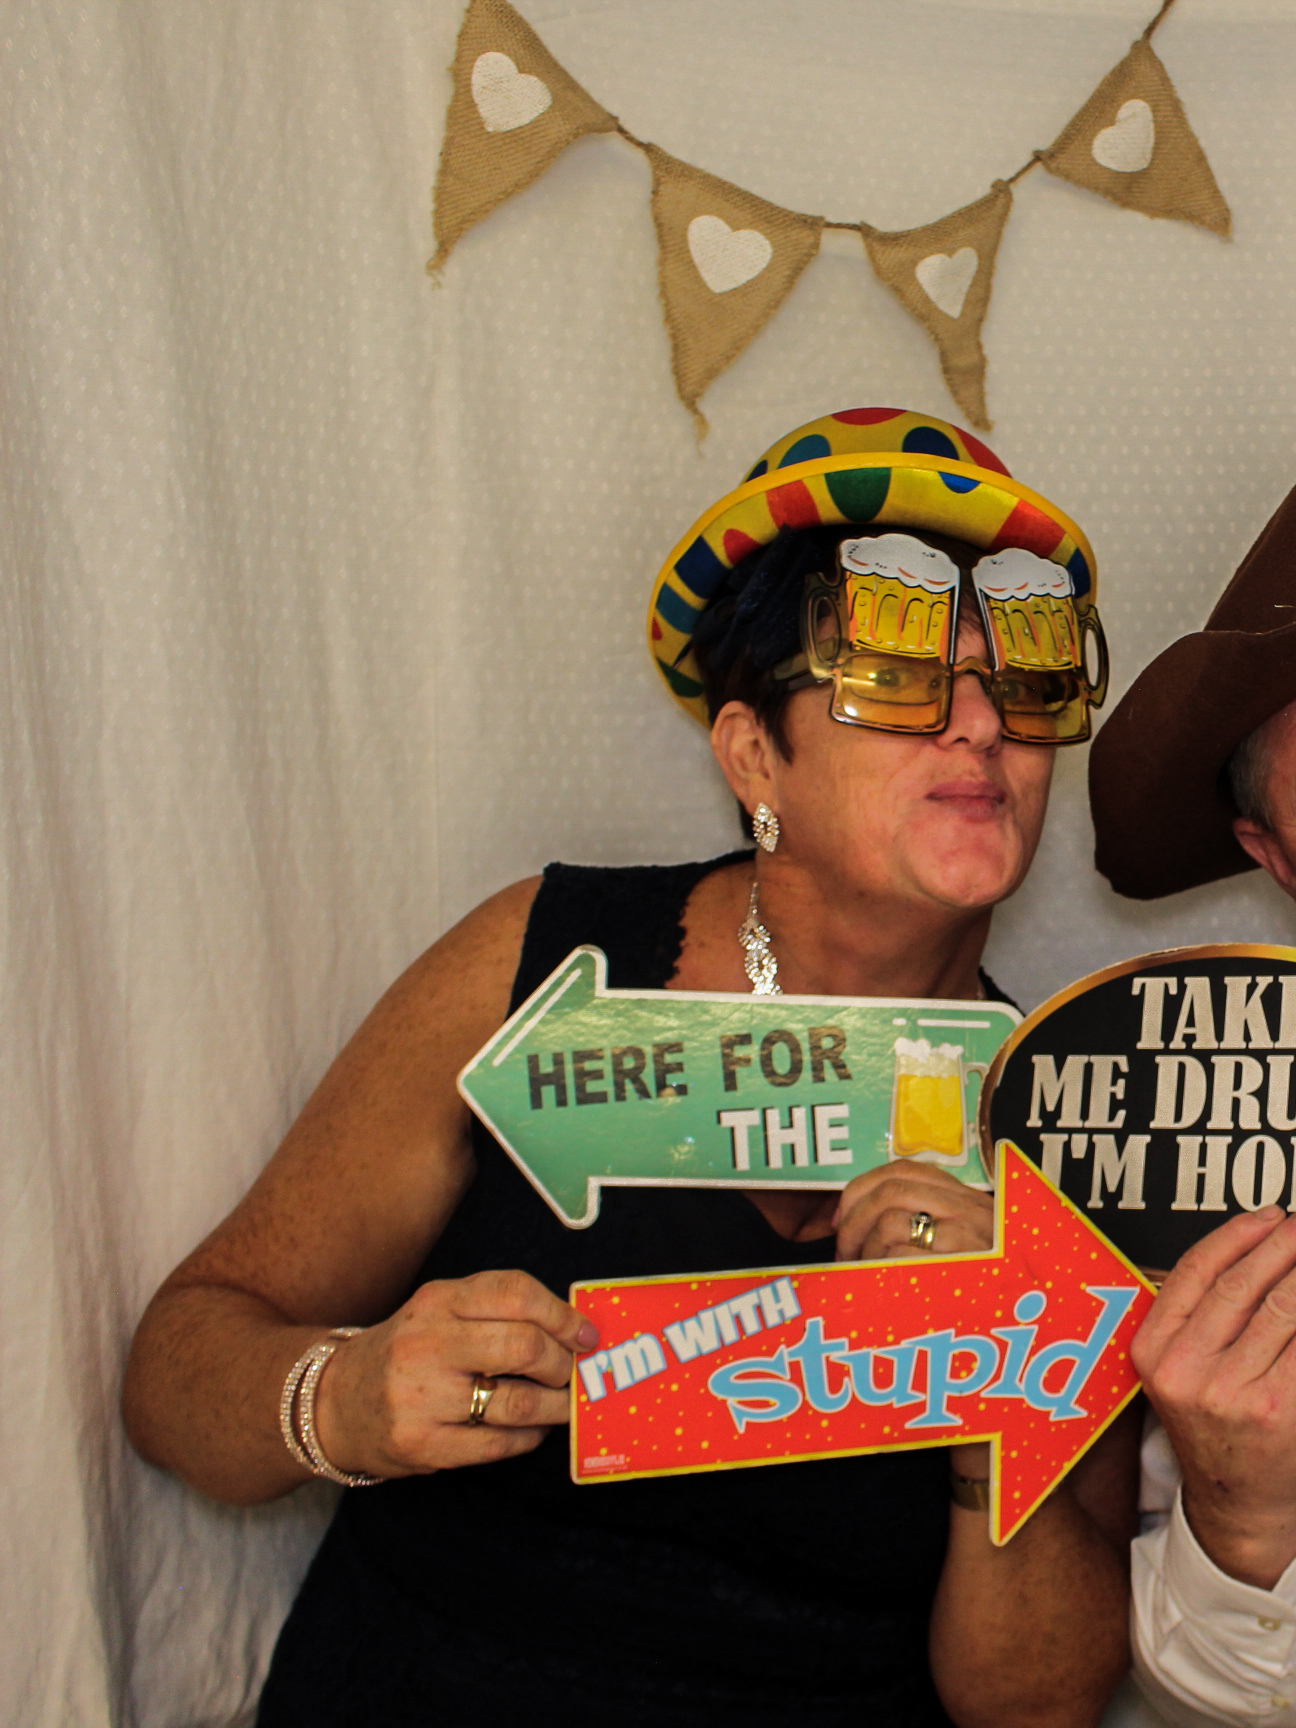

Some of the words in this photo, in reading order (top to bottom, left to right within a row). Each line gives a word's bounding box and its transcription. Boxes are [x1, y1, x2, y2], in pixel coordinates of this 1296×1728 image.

[527, 1041, 688, 1110] HERE
[720, 1026, 853, 1092] FOR
[1026, 1054, 1130, 1129] ME
[716, 1102, 854, 1171] THE
[1039, 1132, 1151, 1210] I'M
[663, 1275, 802, 1363] WITH
[708, 1286, 1140, 1434] stupid
